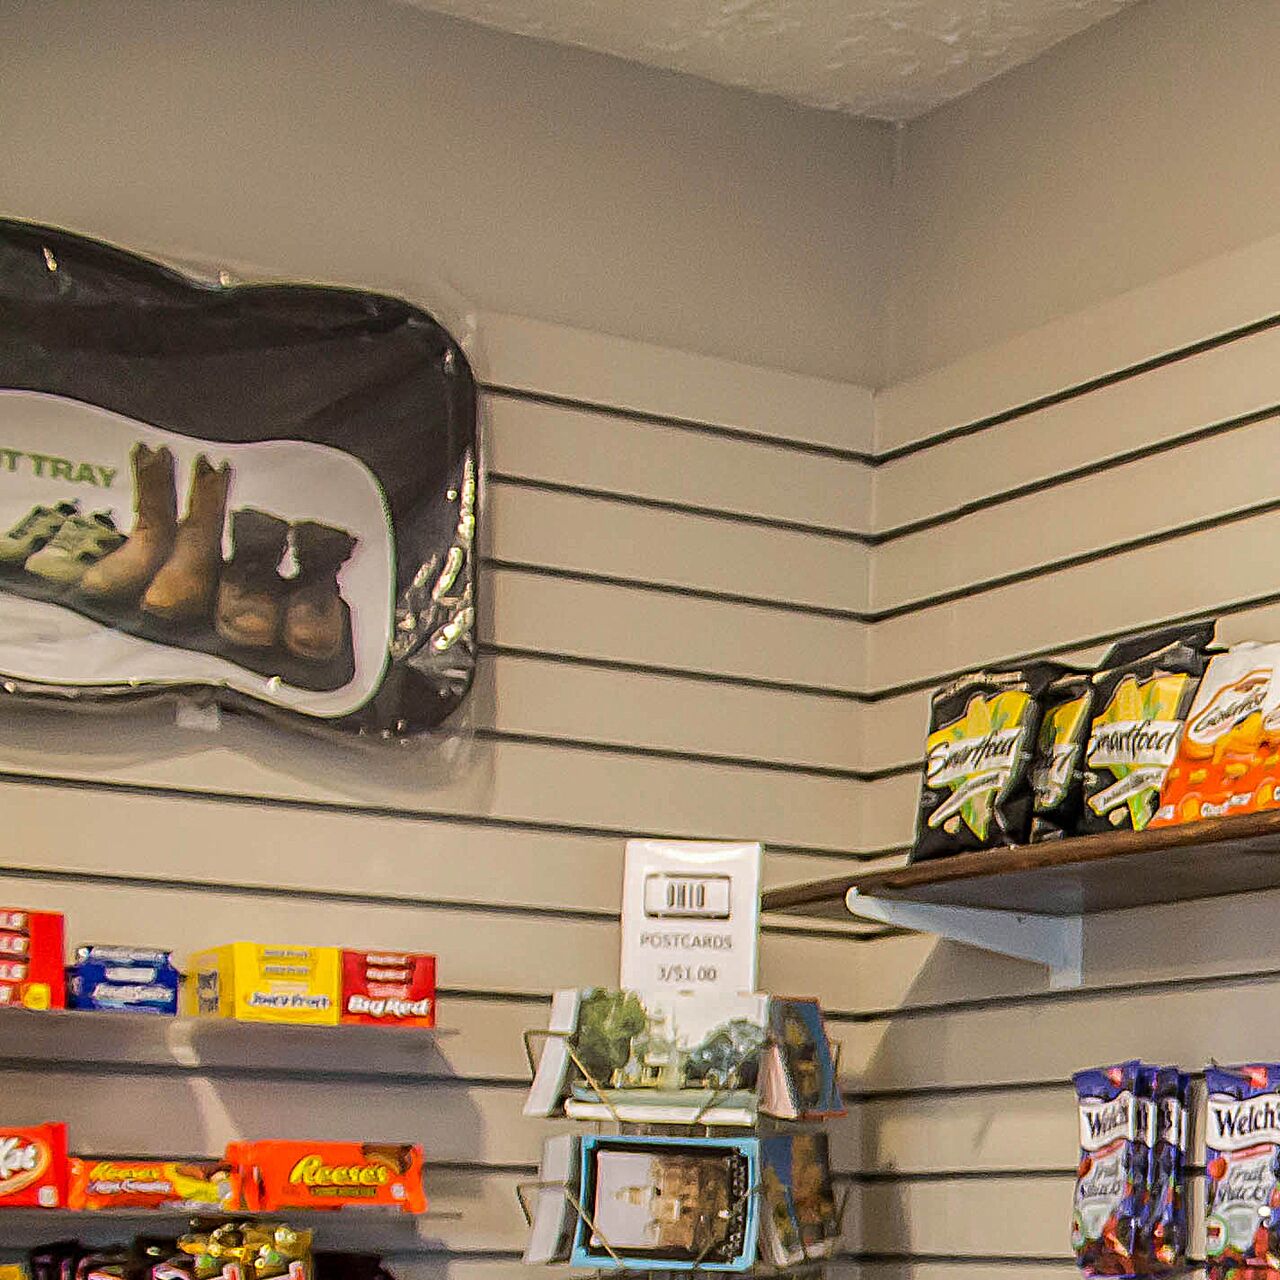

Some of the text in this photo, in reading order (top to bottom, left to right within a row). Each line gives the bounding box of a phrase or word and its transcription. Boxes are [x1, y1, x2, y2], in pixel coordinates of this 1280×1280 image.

[27, 454, 117, 489] TRAY
[667, 882, 706, 909] OHIO
[640, 933, 733, 951] POSTCARDS
[659, 964, 717, 983] 3/$1.00
